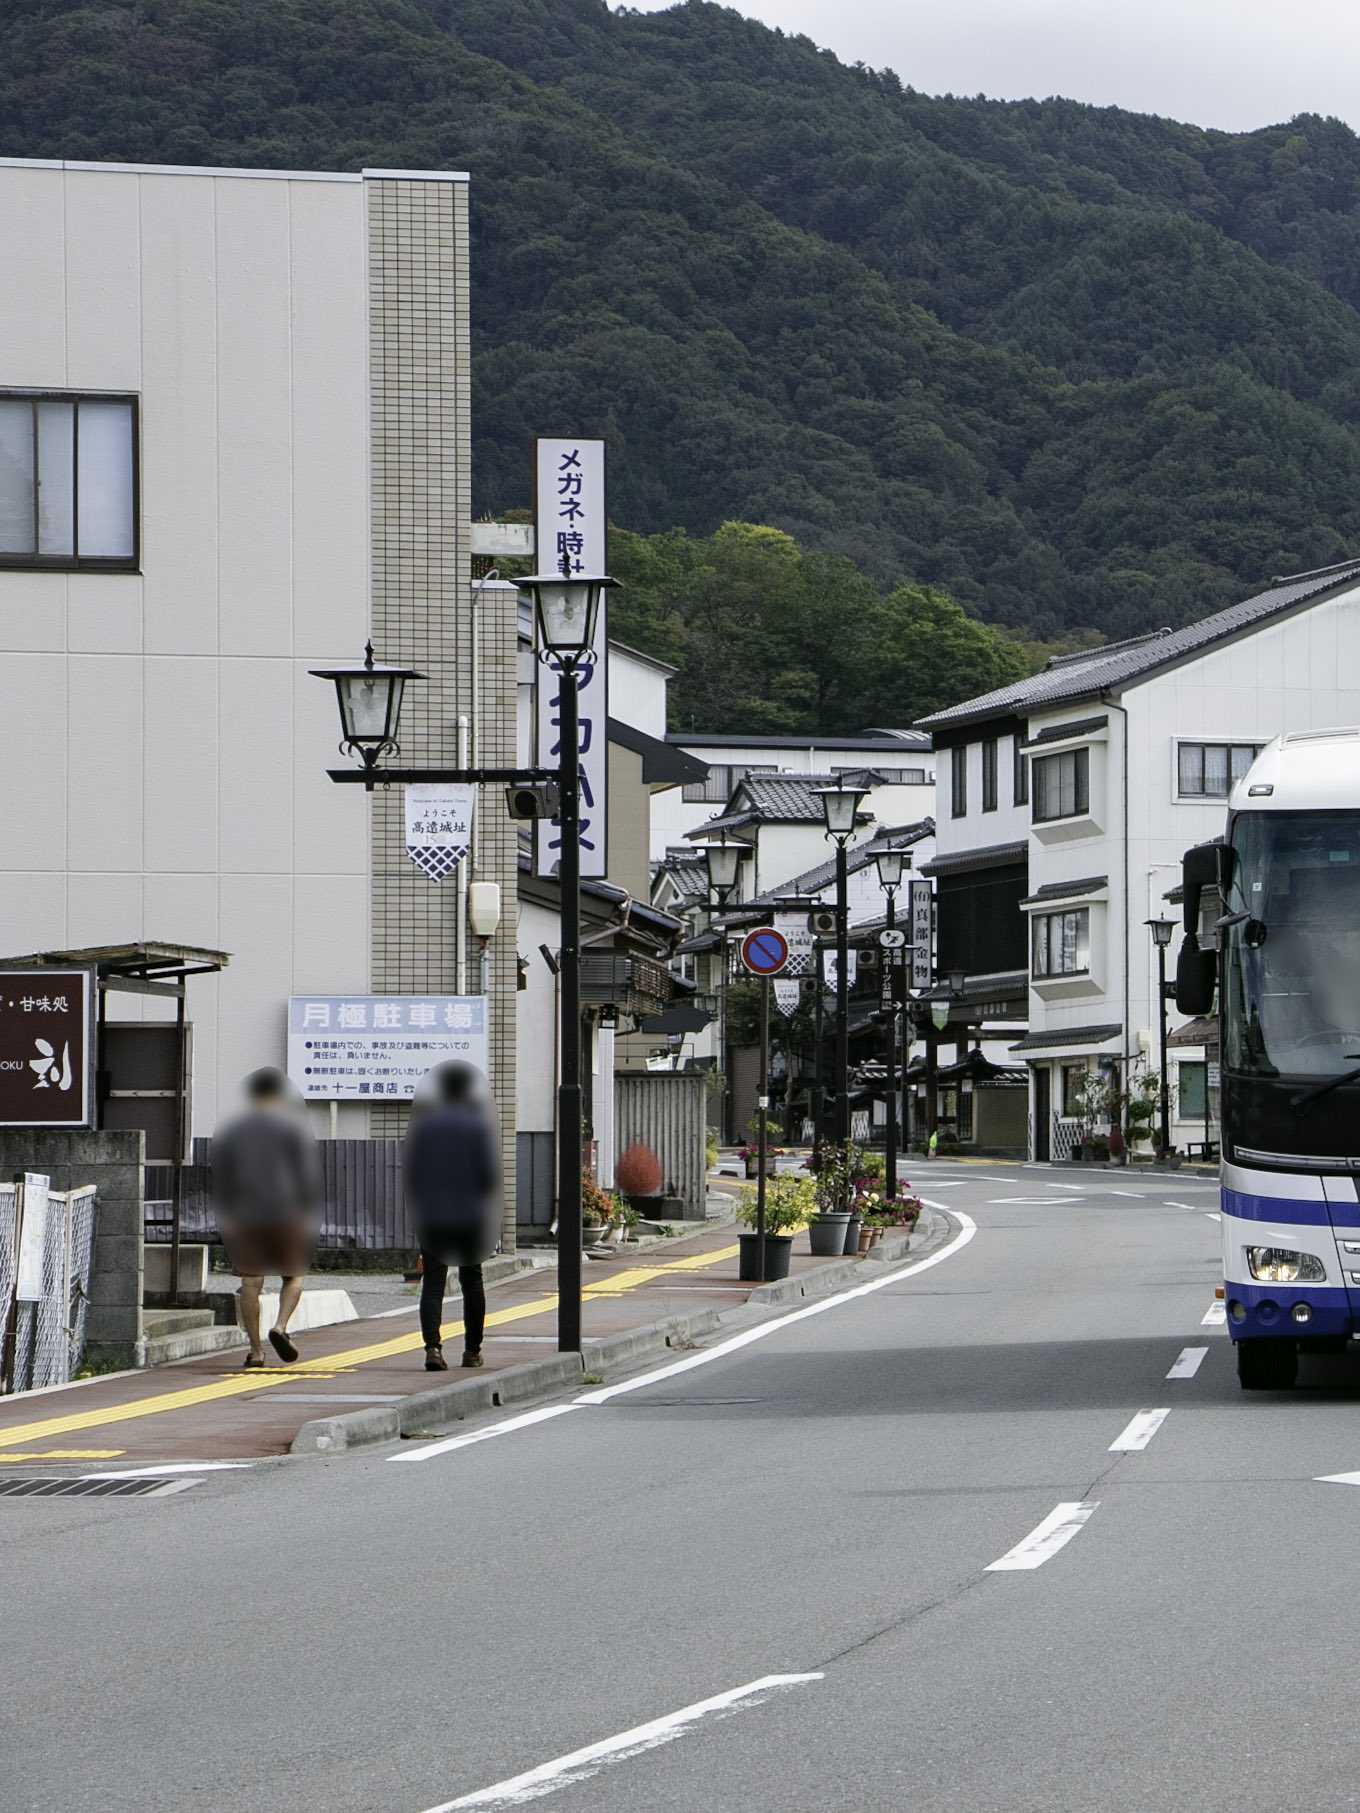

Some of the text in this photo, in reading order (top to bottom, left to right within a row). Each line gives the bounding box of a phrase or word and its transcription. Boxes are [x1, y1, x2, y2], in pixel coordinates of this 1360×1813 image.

[423, 809, 456, 818] ようこそ
[0, 994, 69, 1013] ・甘味処
[302, 1002, 473, 1029] 月極駐車場
[307, 1082, 398, 1094] 連絡先 十一屋商店
